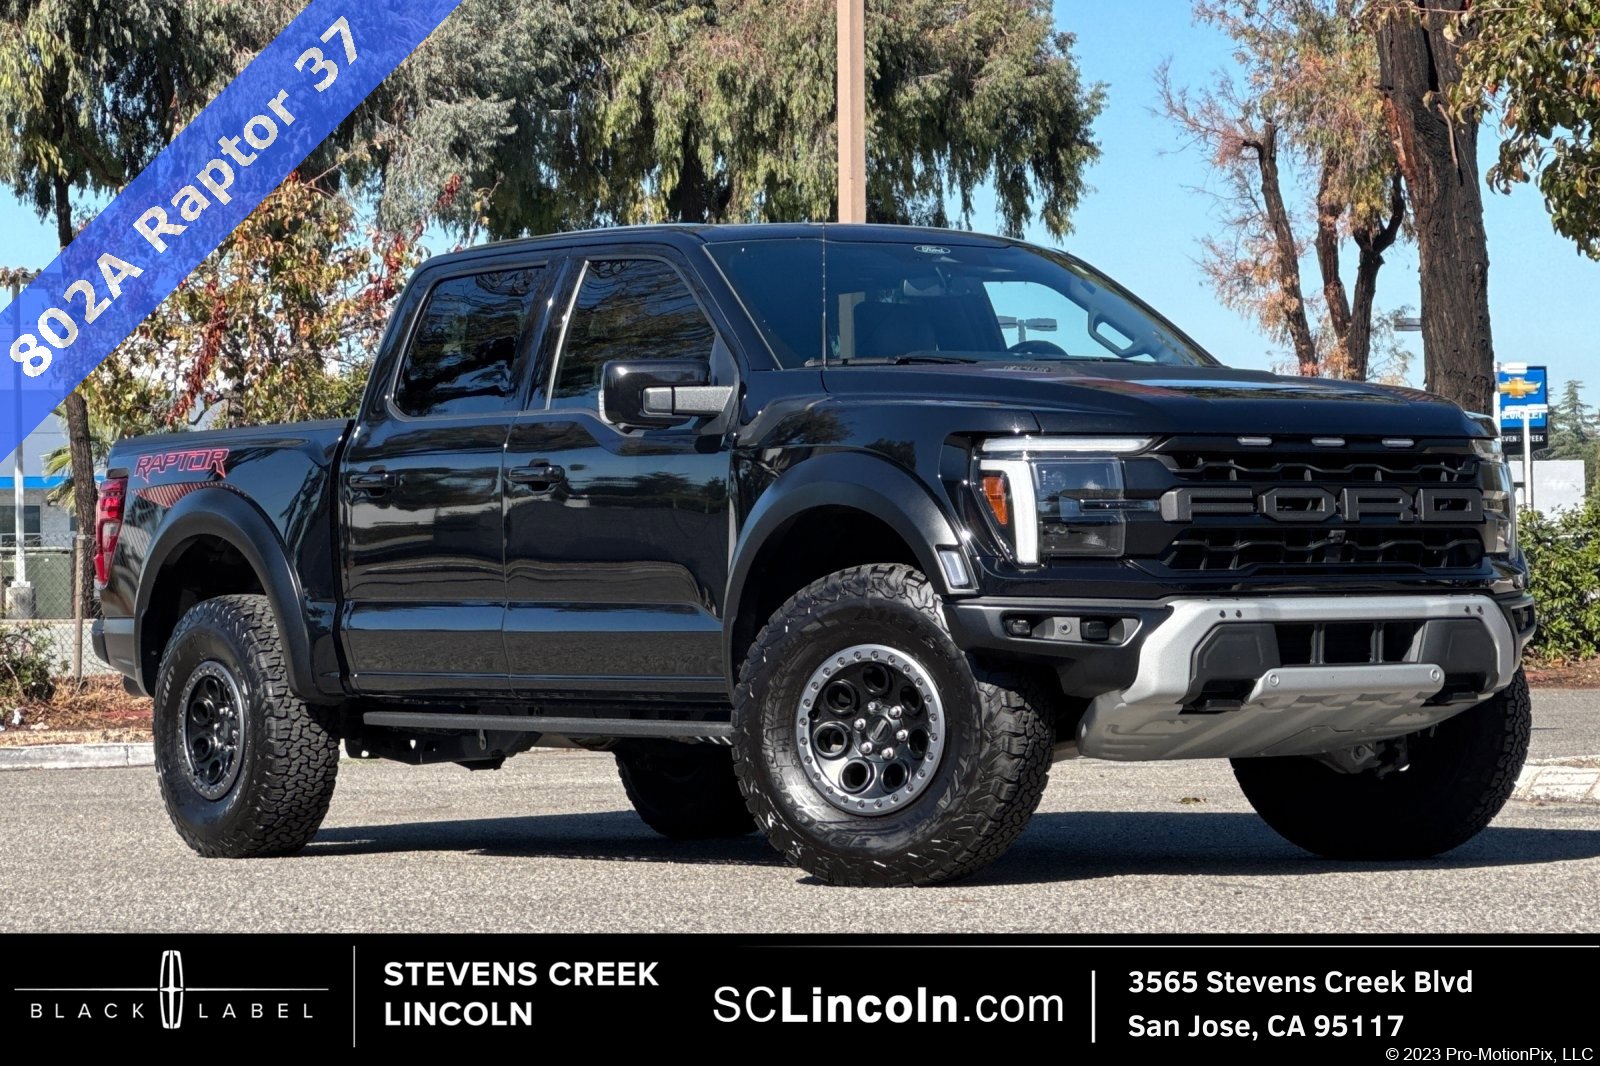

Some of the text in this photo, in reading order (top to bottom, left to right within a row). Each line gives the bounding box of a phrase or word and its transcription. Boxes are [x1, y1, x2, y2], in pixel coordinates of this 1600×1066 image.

[1529, 434, 1544, 442] EEK
[133, 448, 230, 484] RAPTOR
[1160, 487, 1484, 523] FORD
